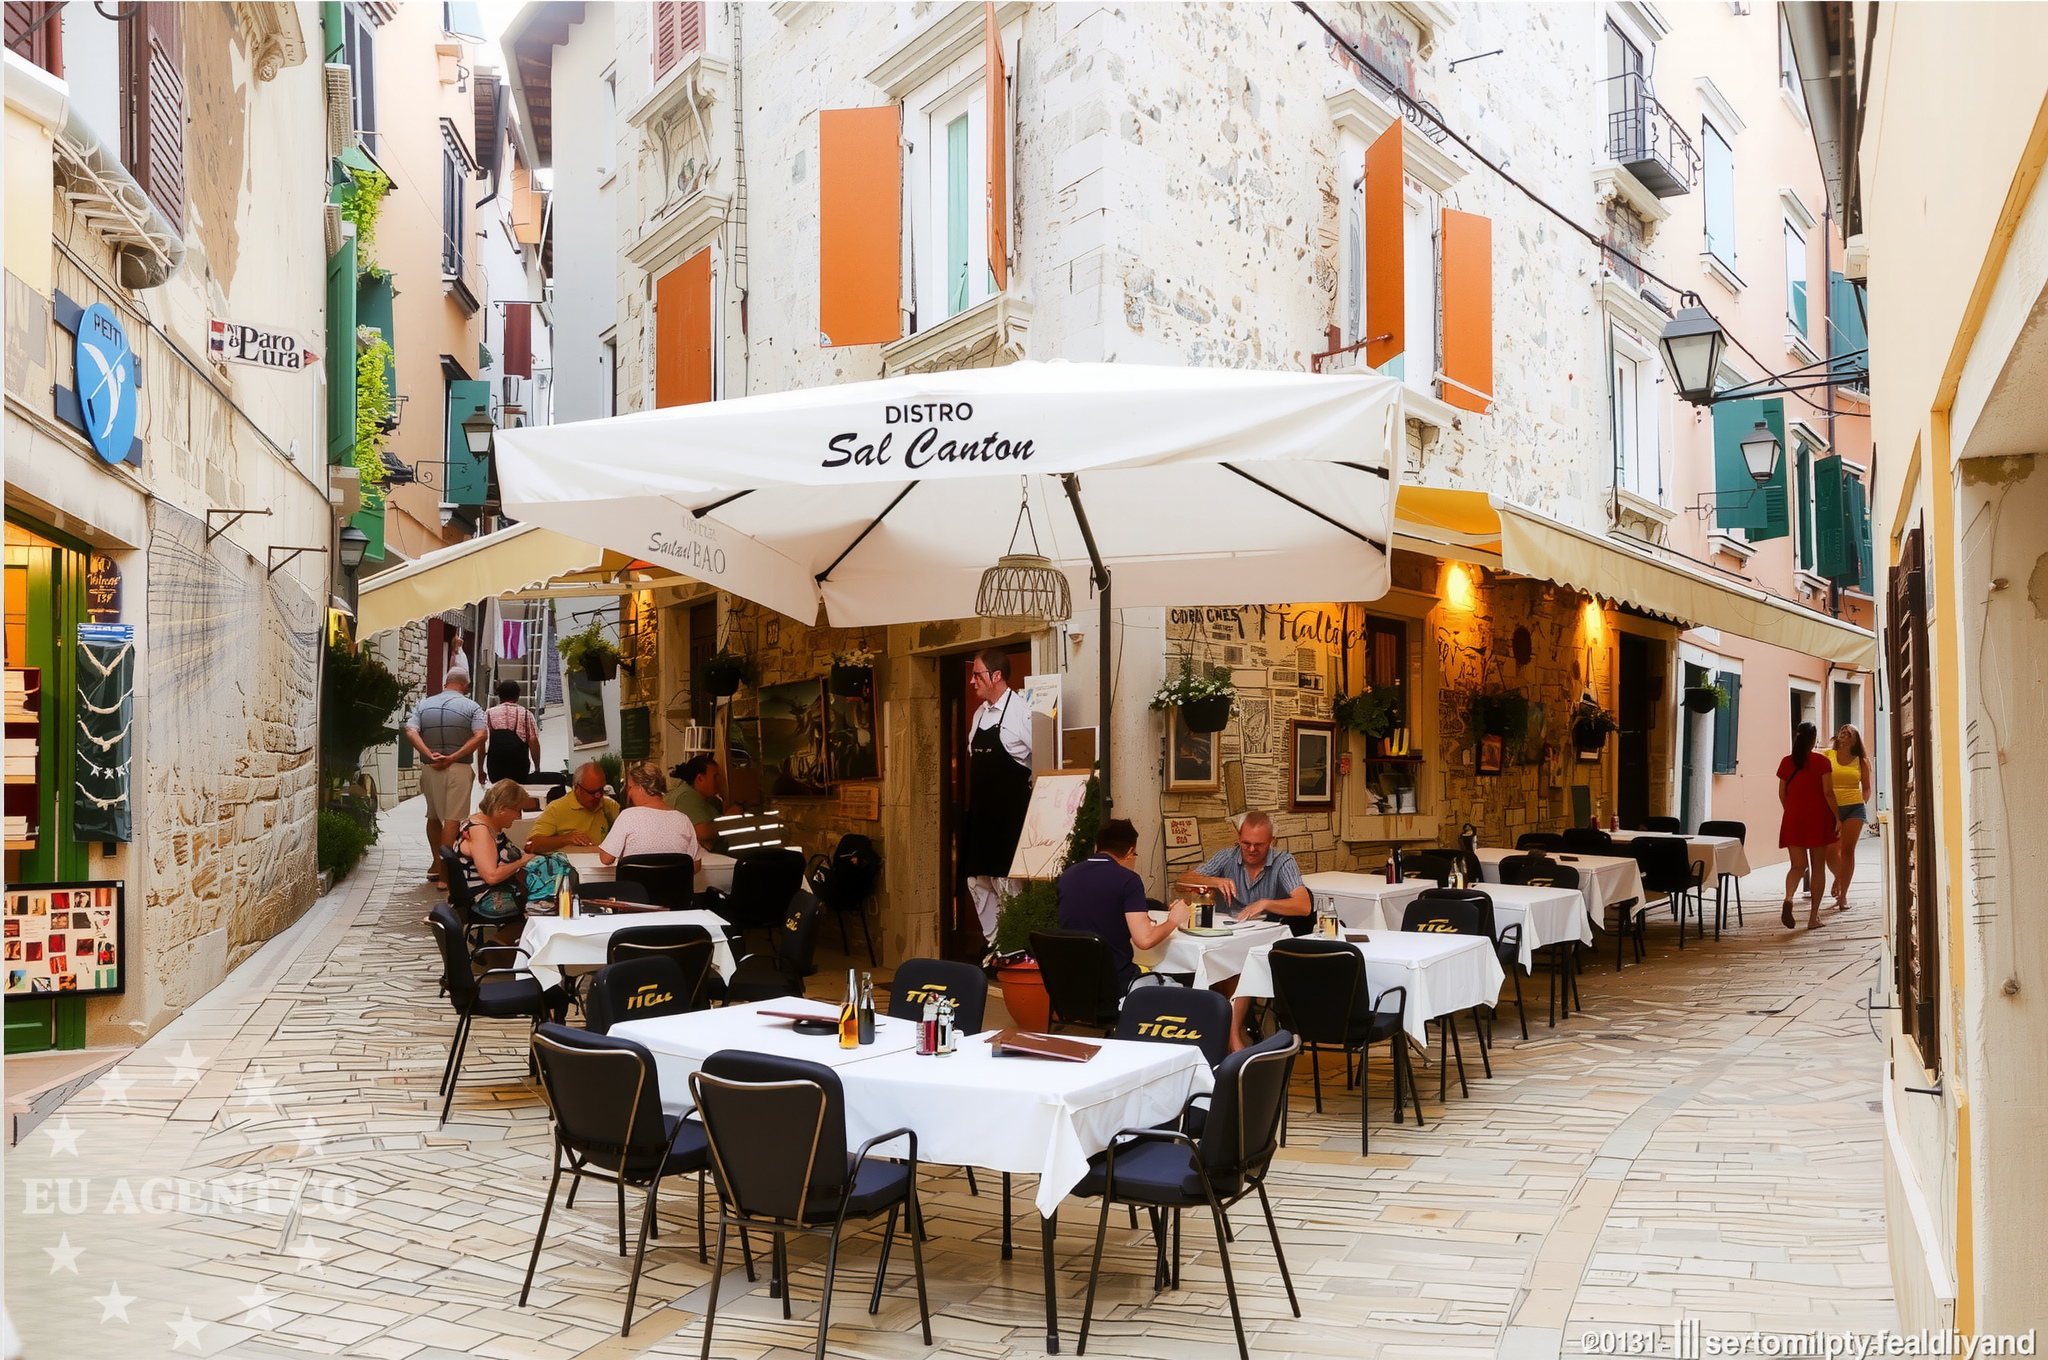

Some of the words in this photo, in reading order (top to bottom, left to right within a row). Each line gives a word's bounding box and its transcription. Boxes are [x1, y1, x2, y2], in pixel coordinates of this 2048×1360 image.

[884, 402, 974, 425] DISTRO
[821, 432, 893, 468] Sal
[904, 427, 1037, 470] Canton
